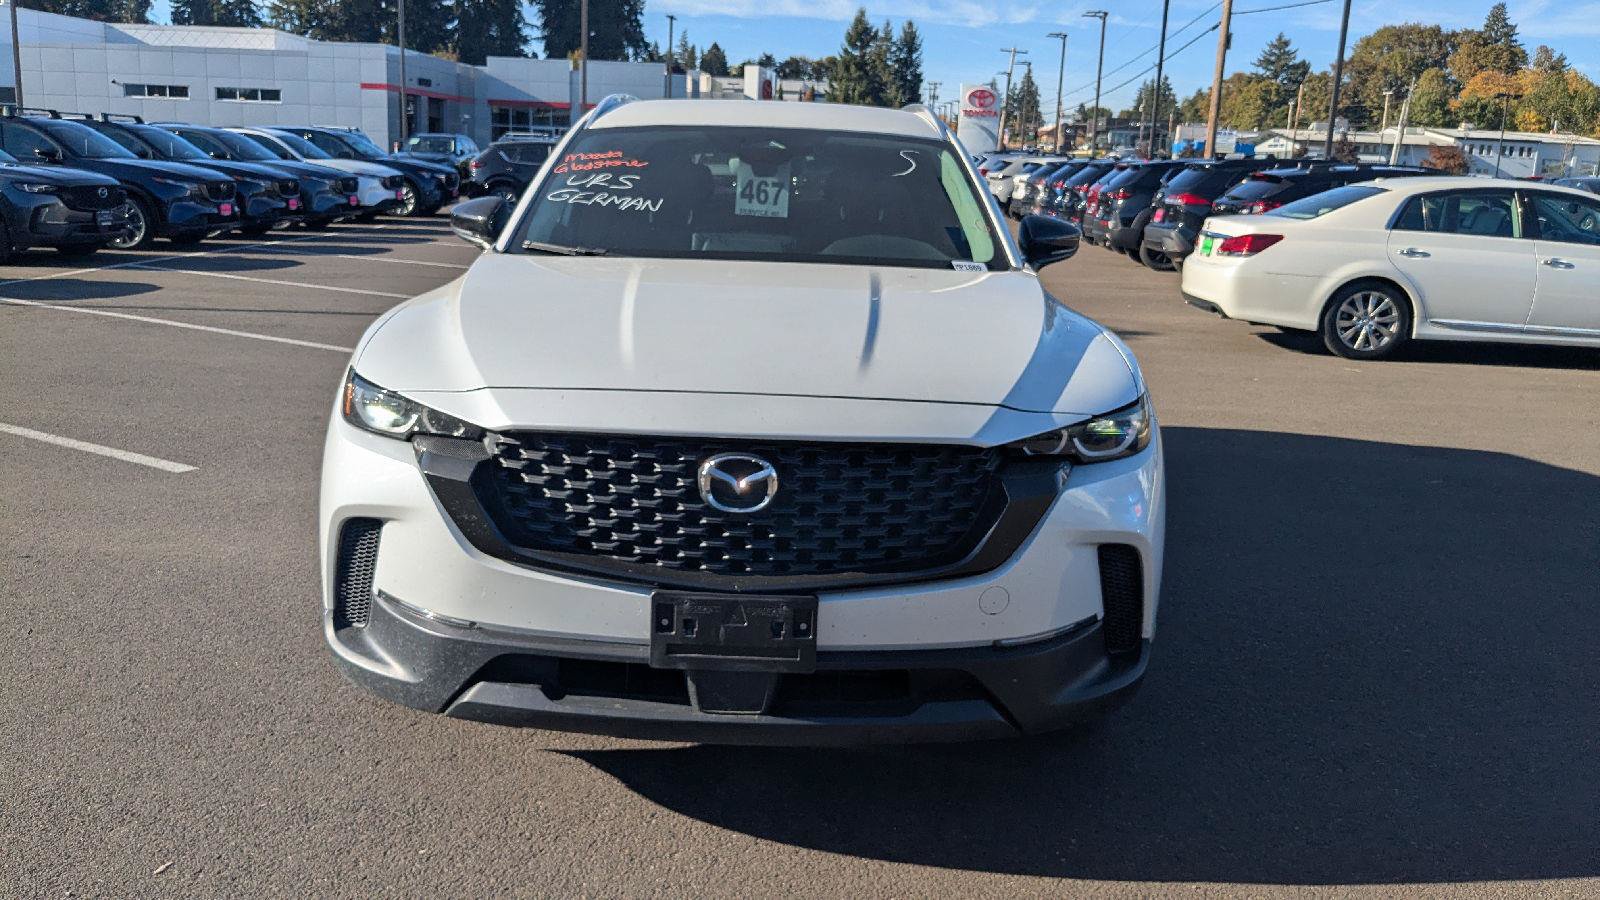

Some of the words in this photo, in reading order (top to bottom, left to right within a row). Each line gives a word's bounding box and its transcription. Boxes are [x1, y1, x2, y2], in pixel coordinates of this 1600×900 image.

[962, 109, 998, 118] TOYOTA
[547, 188, 664, 212] GERMAN
[740, 179, 784, 206] 467
